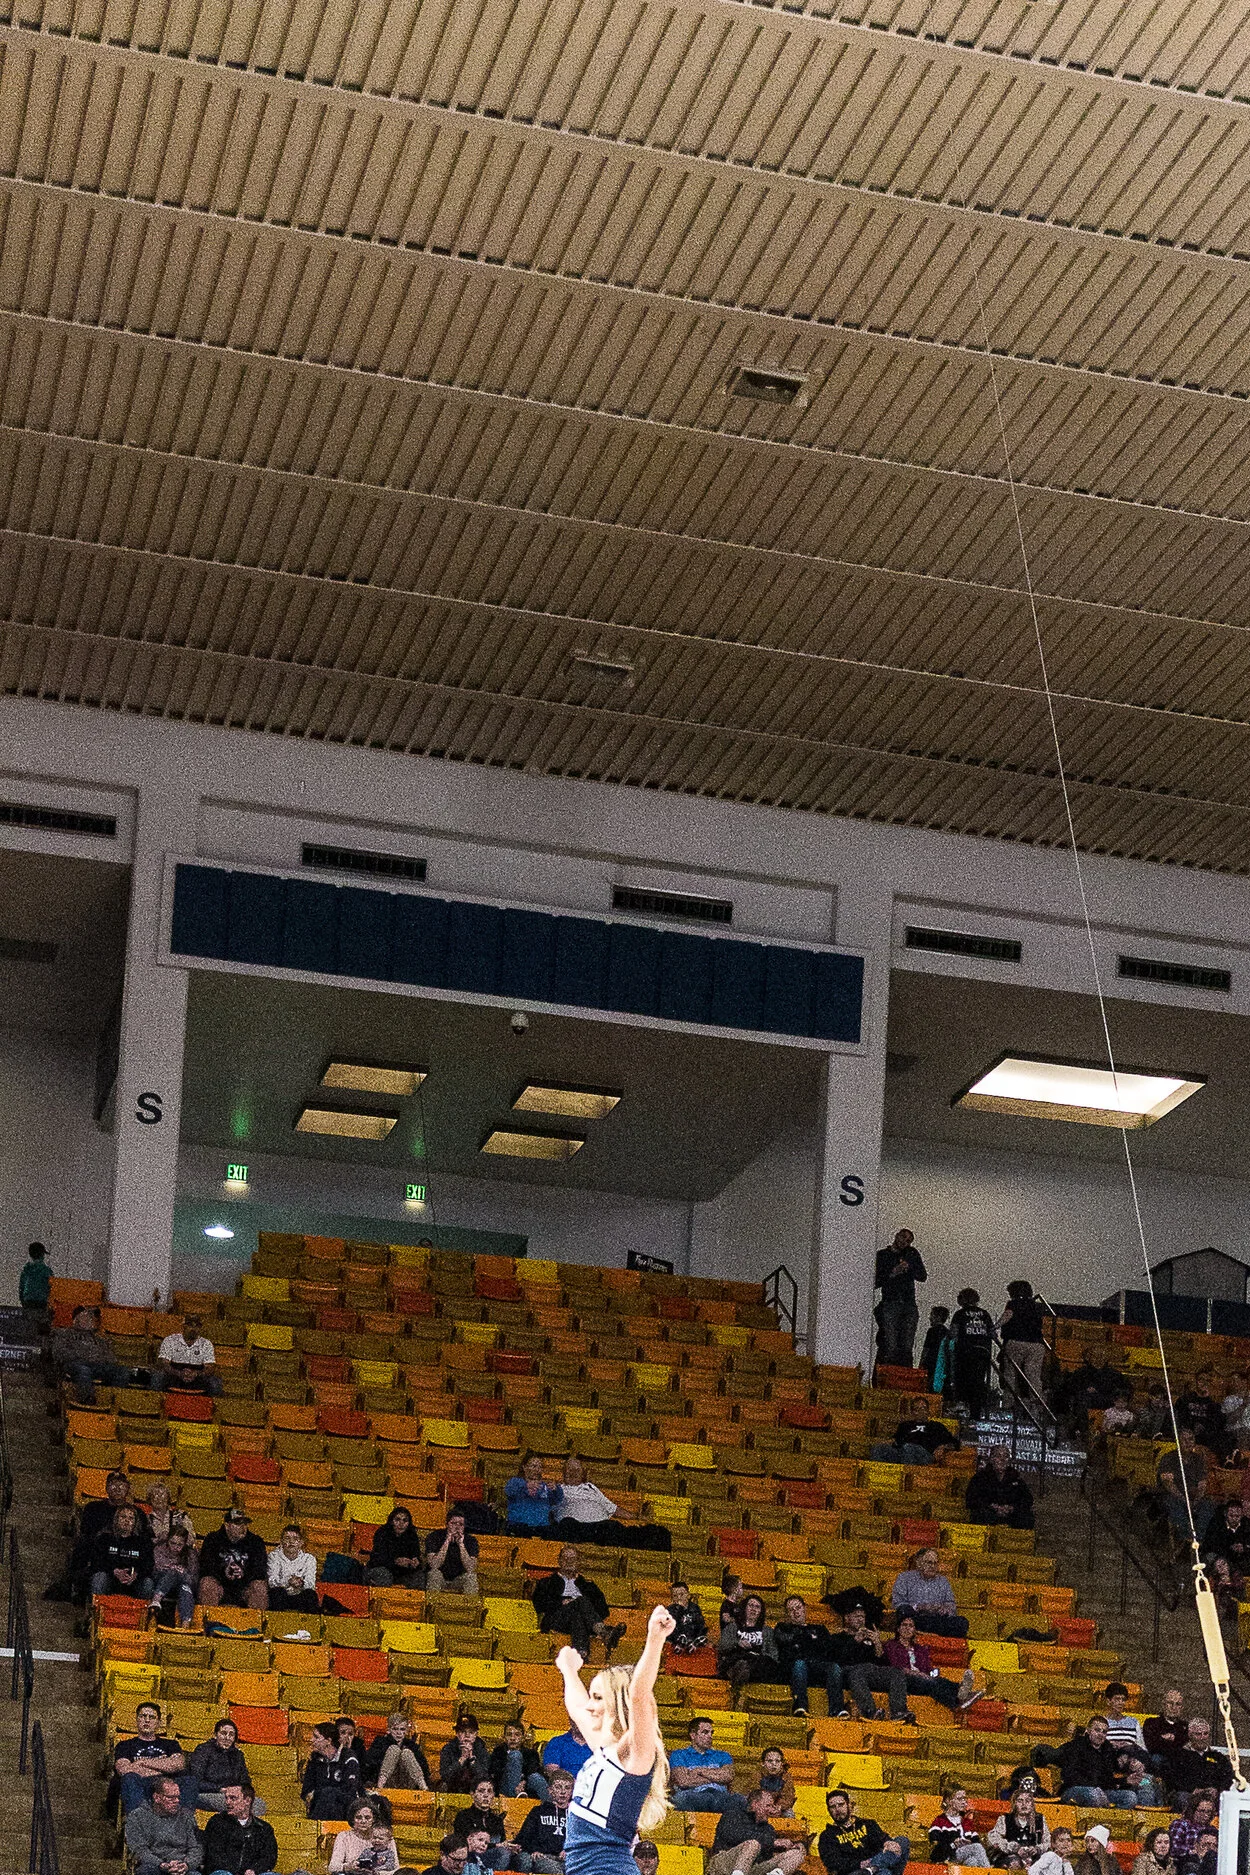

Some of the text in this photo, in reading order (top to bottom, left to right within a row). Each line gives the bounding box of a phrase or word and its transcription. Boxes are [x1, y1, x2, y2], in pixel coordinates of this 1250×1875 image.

[136, 1092, 163, 1125] S
[228, 1164, 248, 1181] EXIT
[406, 1184, 426, 1201] EXIT
[839, 1175, 865, 1207] S
[540, 1815, 559, 1825] UTAH
